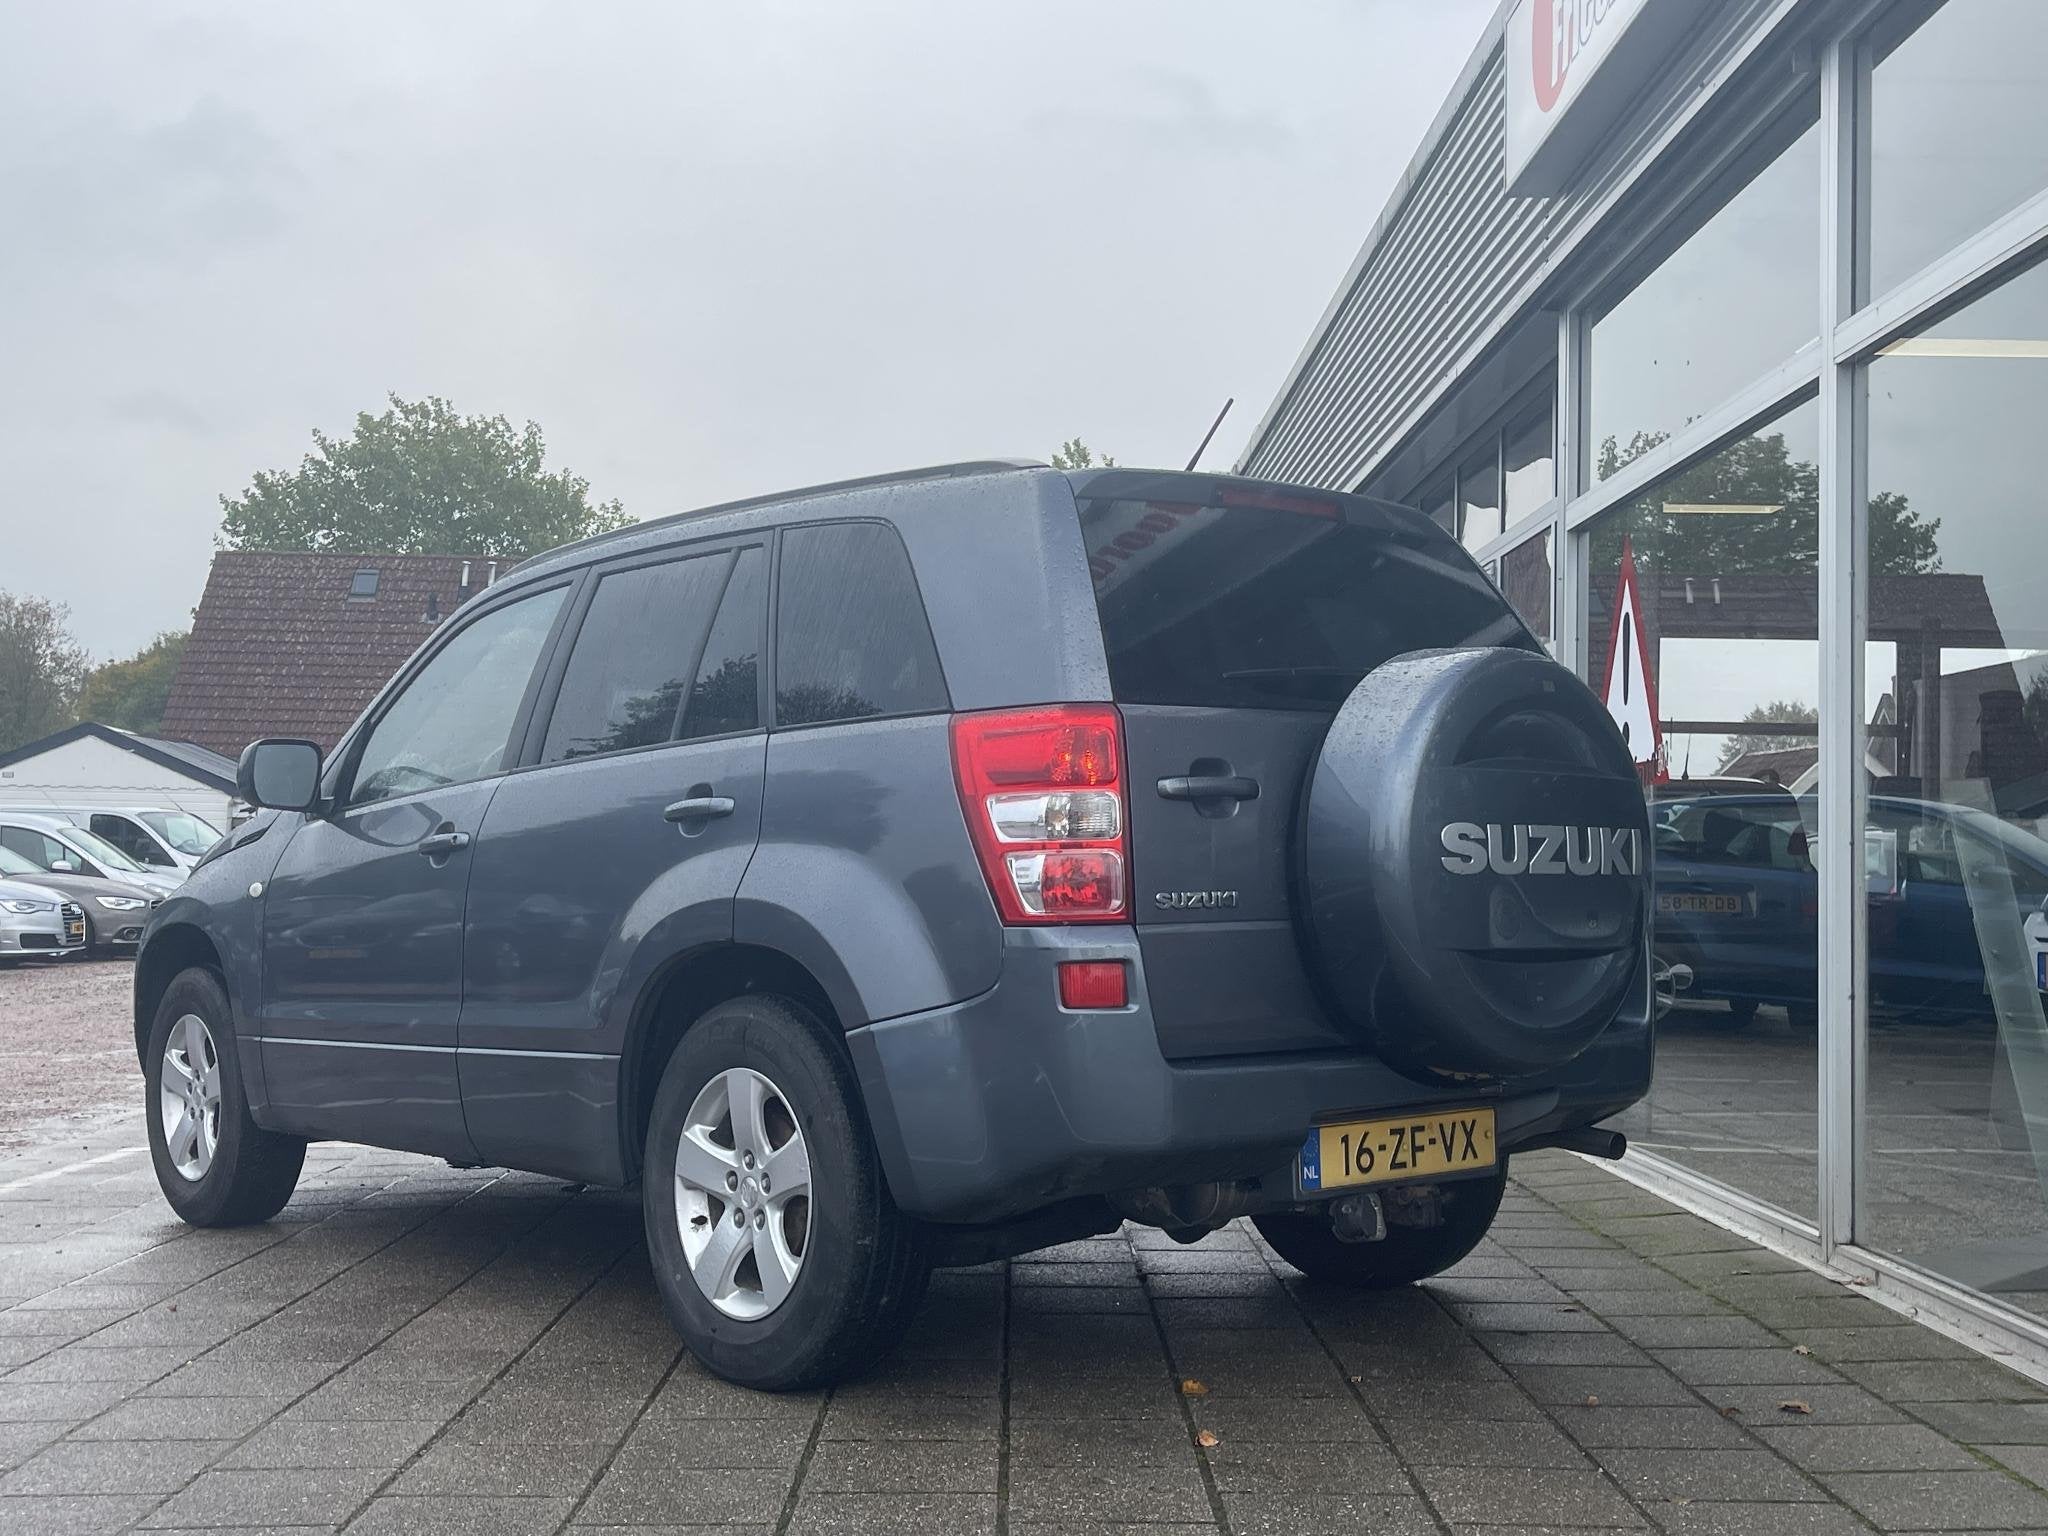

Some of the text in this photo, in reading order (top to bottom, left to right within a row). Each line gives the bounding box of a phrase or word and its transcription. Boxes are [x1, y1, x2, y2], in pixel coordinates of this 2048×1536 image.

[1440, 822, 1642, 875] SUZUKI
[1154, 891, 1238, 909] SUZUKI
[1340, 1119, 1478, 1176] 16-ZF-VX
[1304, 1166, 1319, 1180] NL
